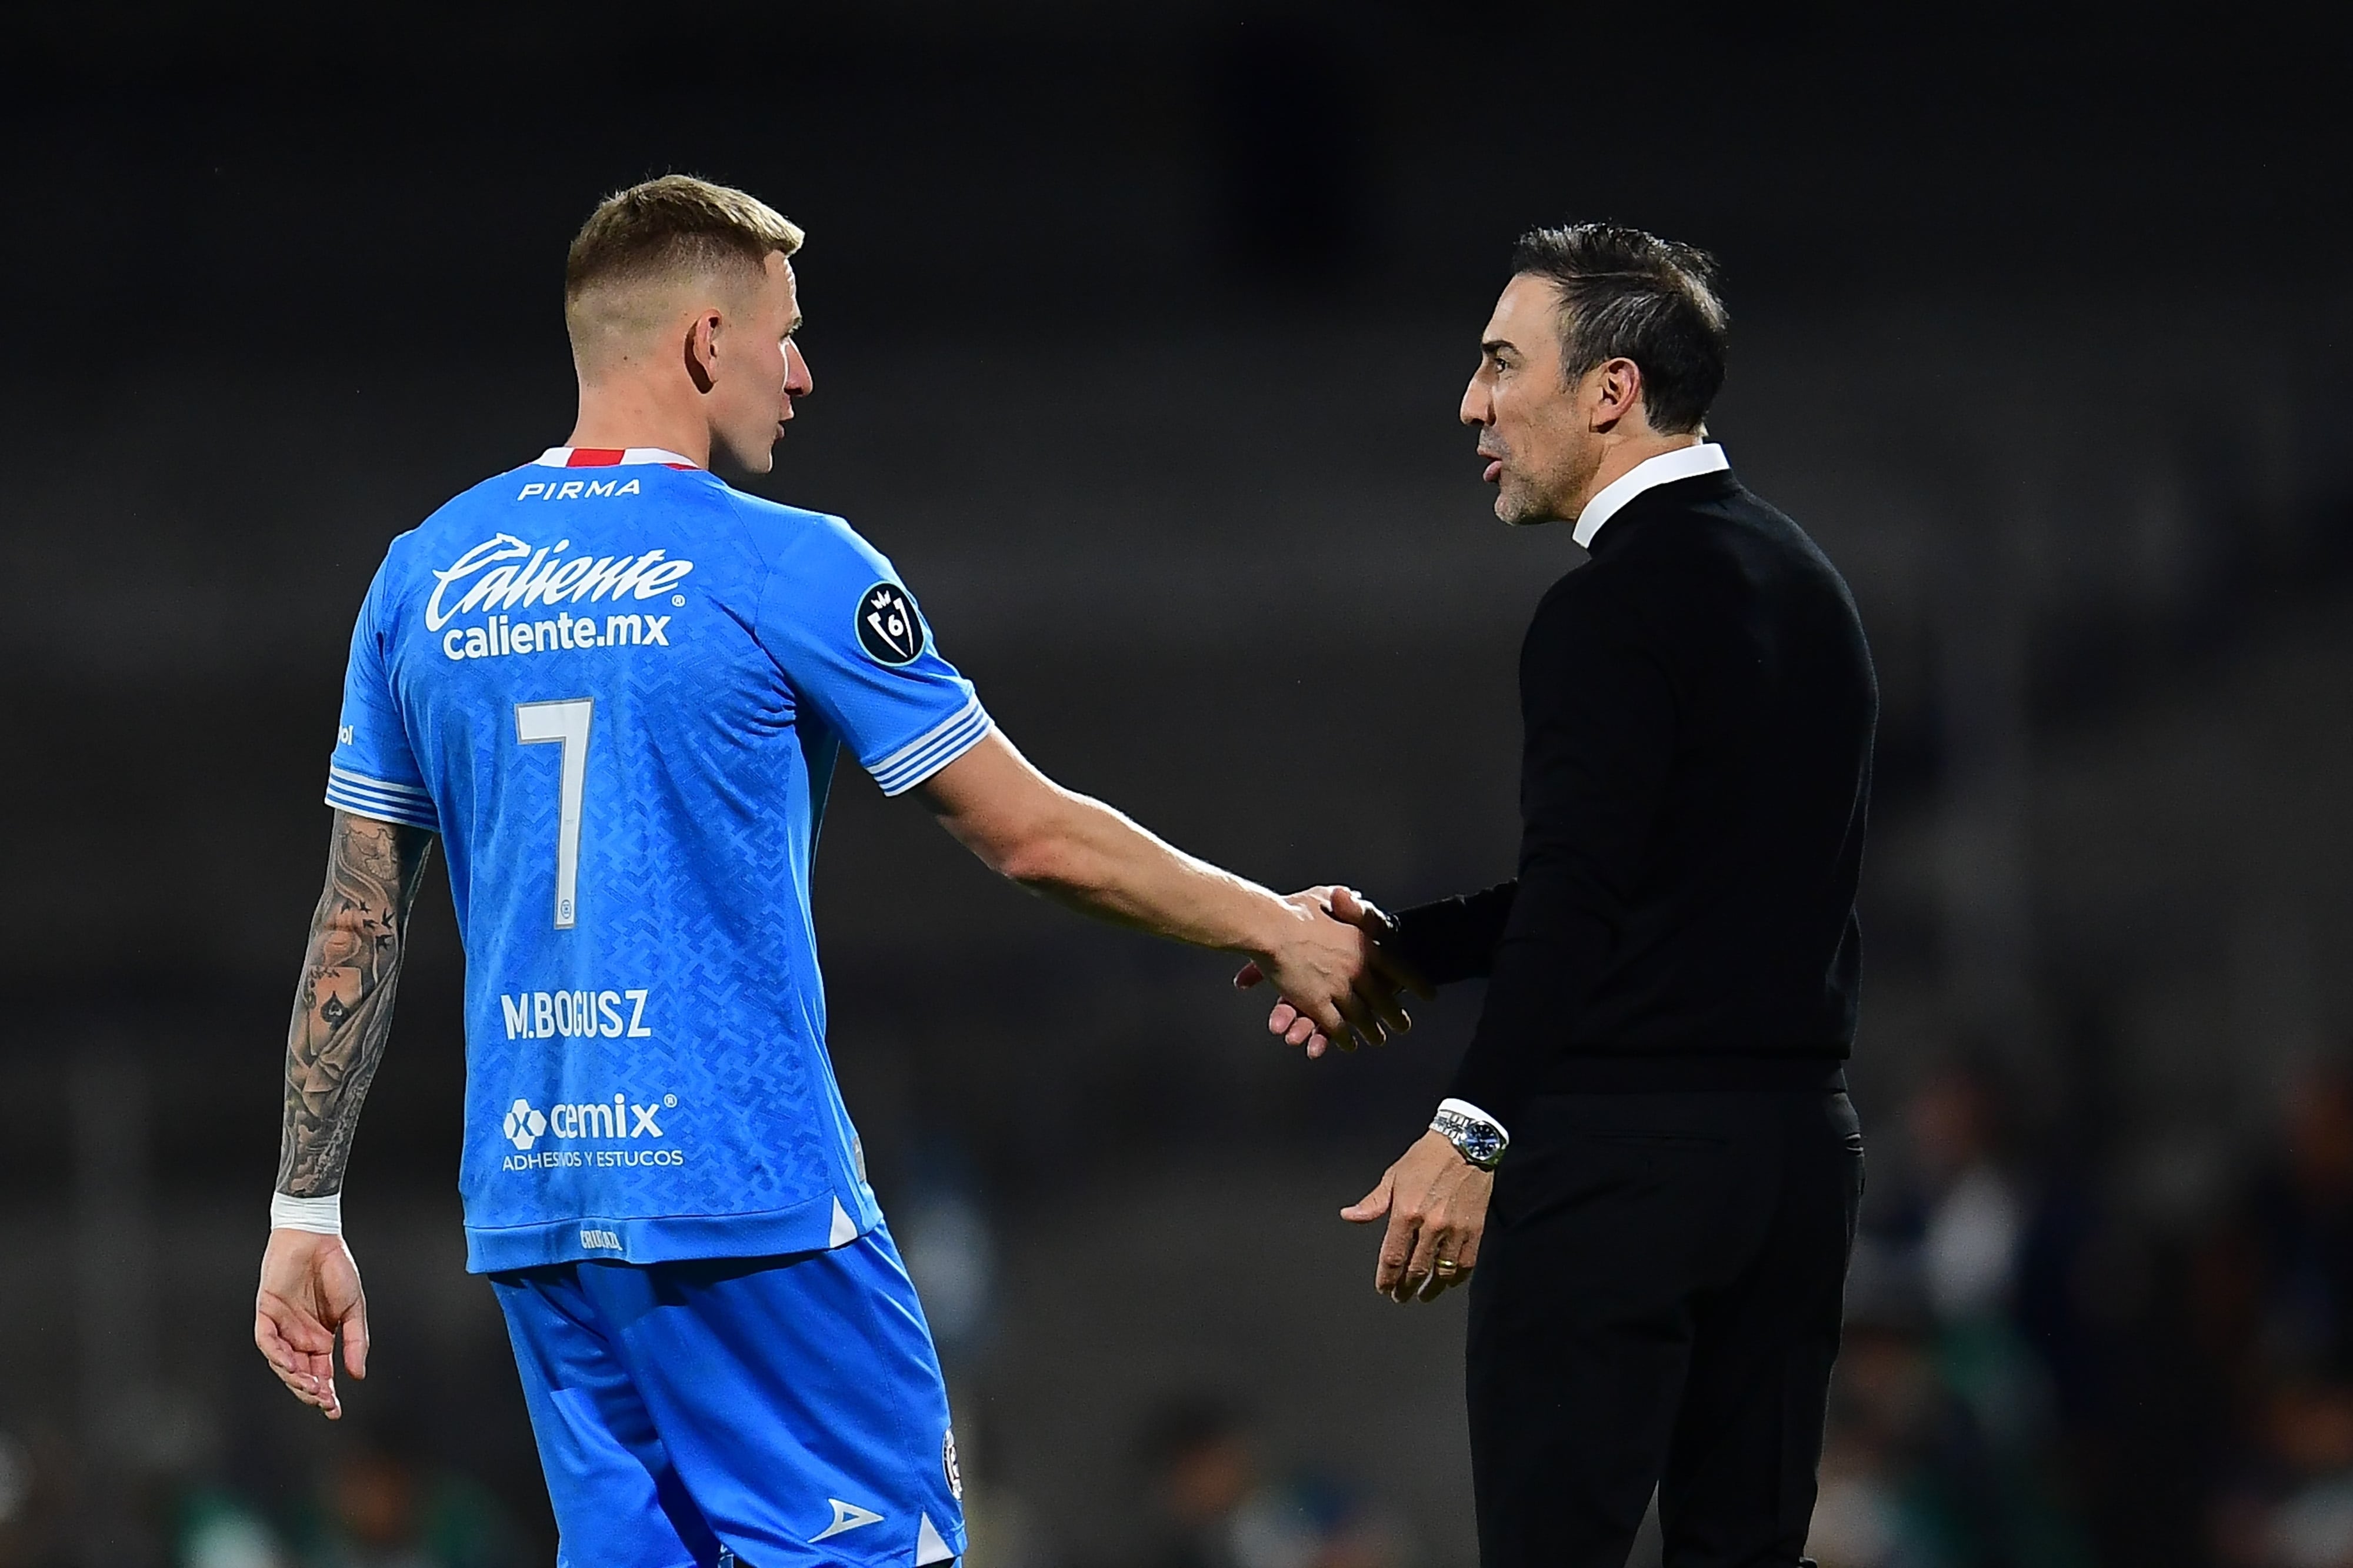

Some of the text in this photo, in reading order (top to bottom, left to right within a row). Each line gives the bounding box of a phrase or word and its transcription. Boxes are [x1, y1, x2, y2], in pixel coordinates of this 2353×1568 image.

[517, 479, 640, 501] PIRMA
[425, 533, 694, 632] Caliente
[443, 612, 671, 660] caliente.mx
[888, 613, 904, 637] 6
[514, 698, 594, 930] 7
[501, 989, 651, 1039] M.BOGUSZ
[551, 1093, 663, 1139] cemix
[584, 1152, 592, 1166] Y
[596, 1150, 684, 1167] ESTUCOS
